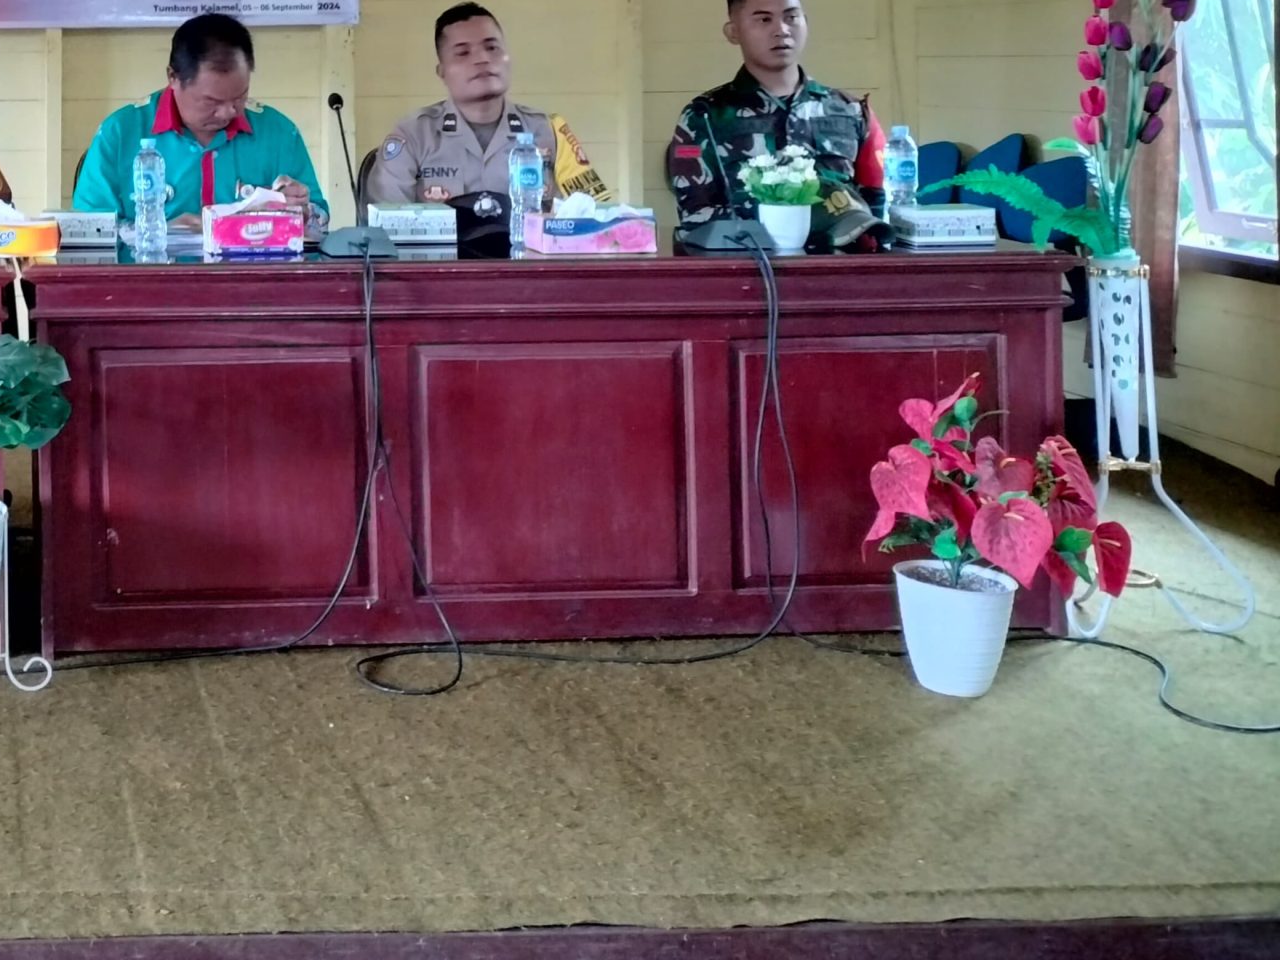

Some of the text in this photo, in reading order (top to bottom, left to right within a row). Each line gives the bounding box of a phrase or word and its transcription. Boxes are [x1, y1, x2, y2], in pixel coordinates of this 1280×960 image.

[153, 4, 198, 13] Tumbang
[271, 3, 313, 13] September
[318, 2, 341, 11] 2024
[546, 221, 575, 230] PASEO
